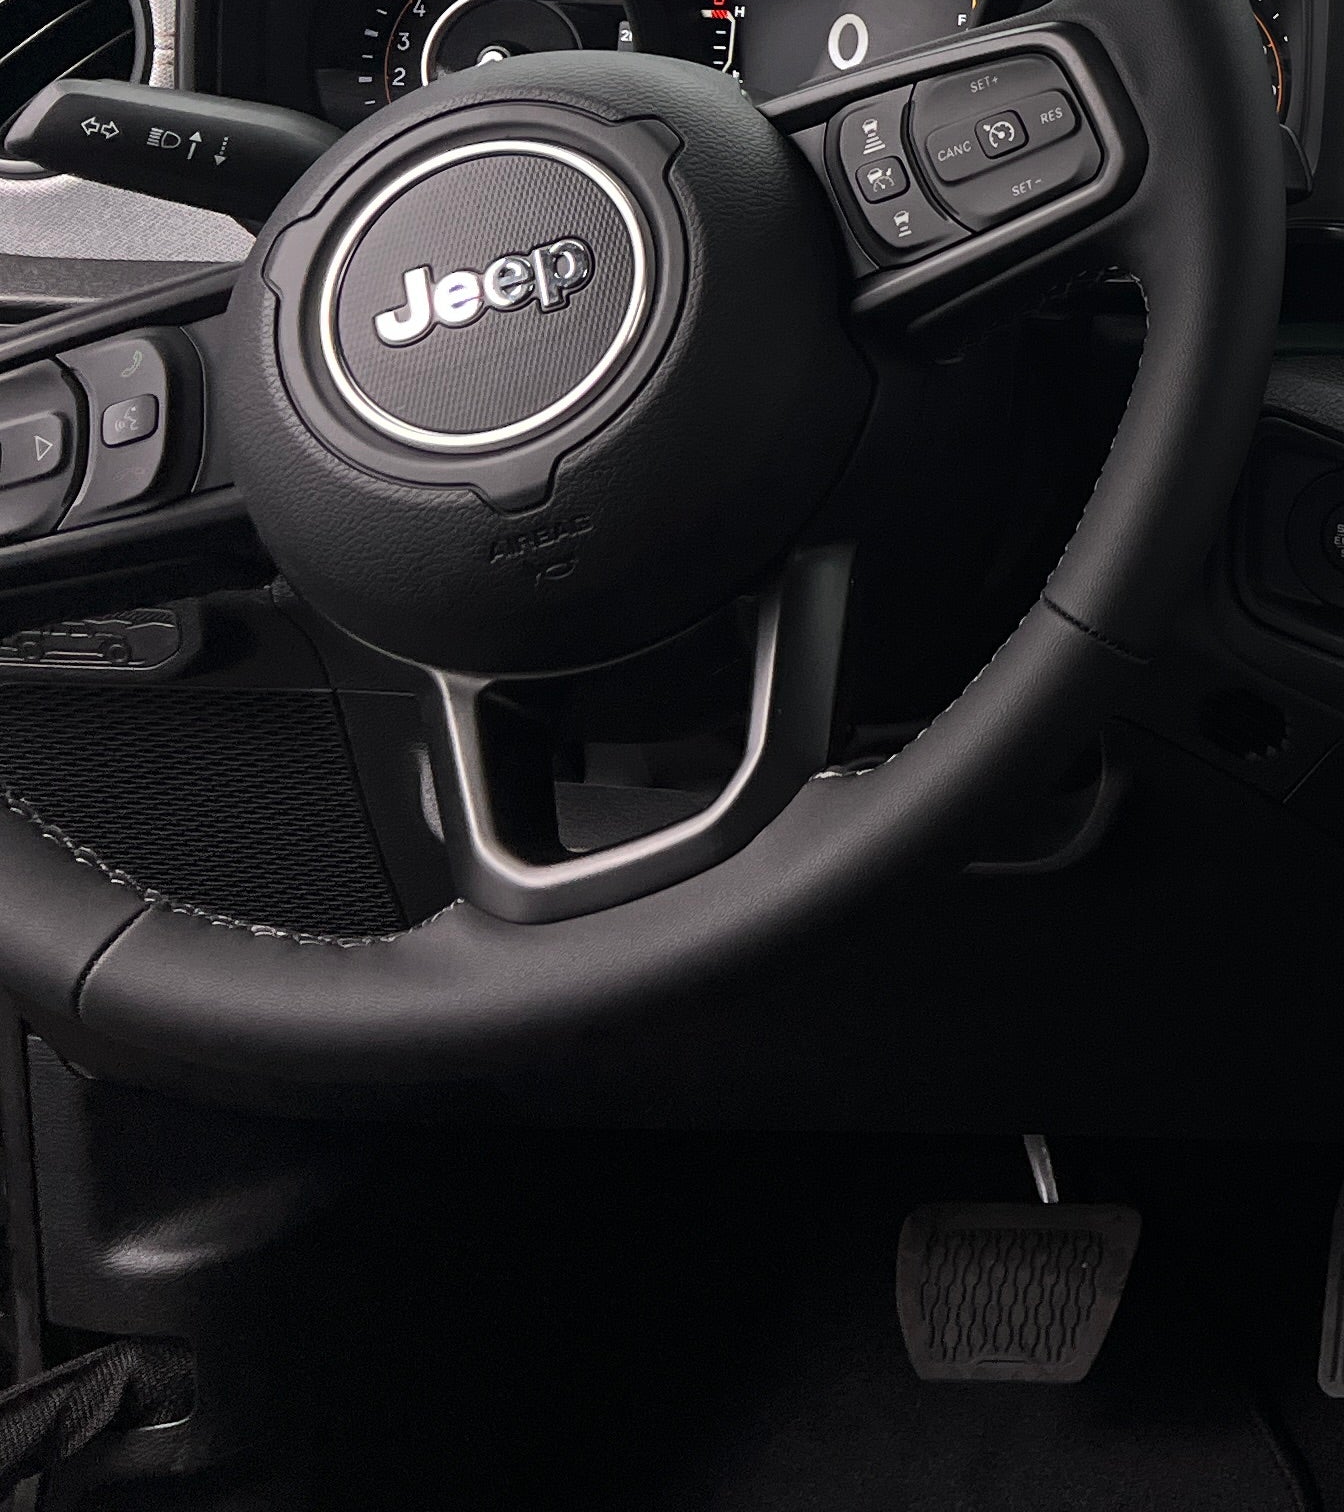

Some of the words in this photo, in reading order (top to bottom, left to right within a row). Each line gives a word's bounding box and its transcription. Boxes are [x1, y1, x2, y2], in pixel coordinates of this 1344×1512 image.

[413, 0, 426, 16] 4
[735, 6, 745, 18] H
[957, 14, 967, 26] F
[398, 32, 410, 49] 3
[828, 14, 868, 70] 0
[392, 68, 405, 86] 2
[1040, 108, 1062, 124] RES
[938, 140, 972, 162] CANC
[373, 236, 595, 348] Jeep
